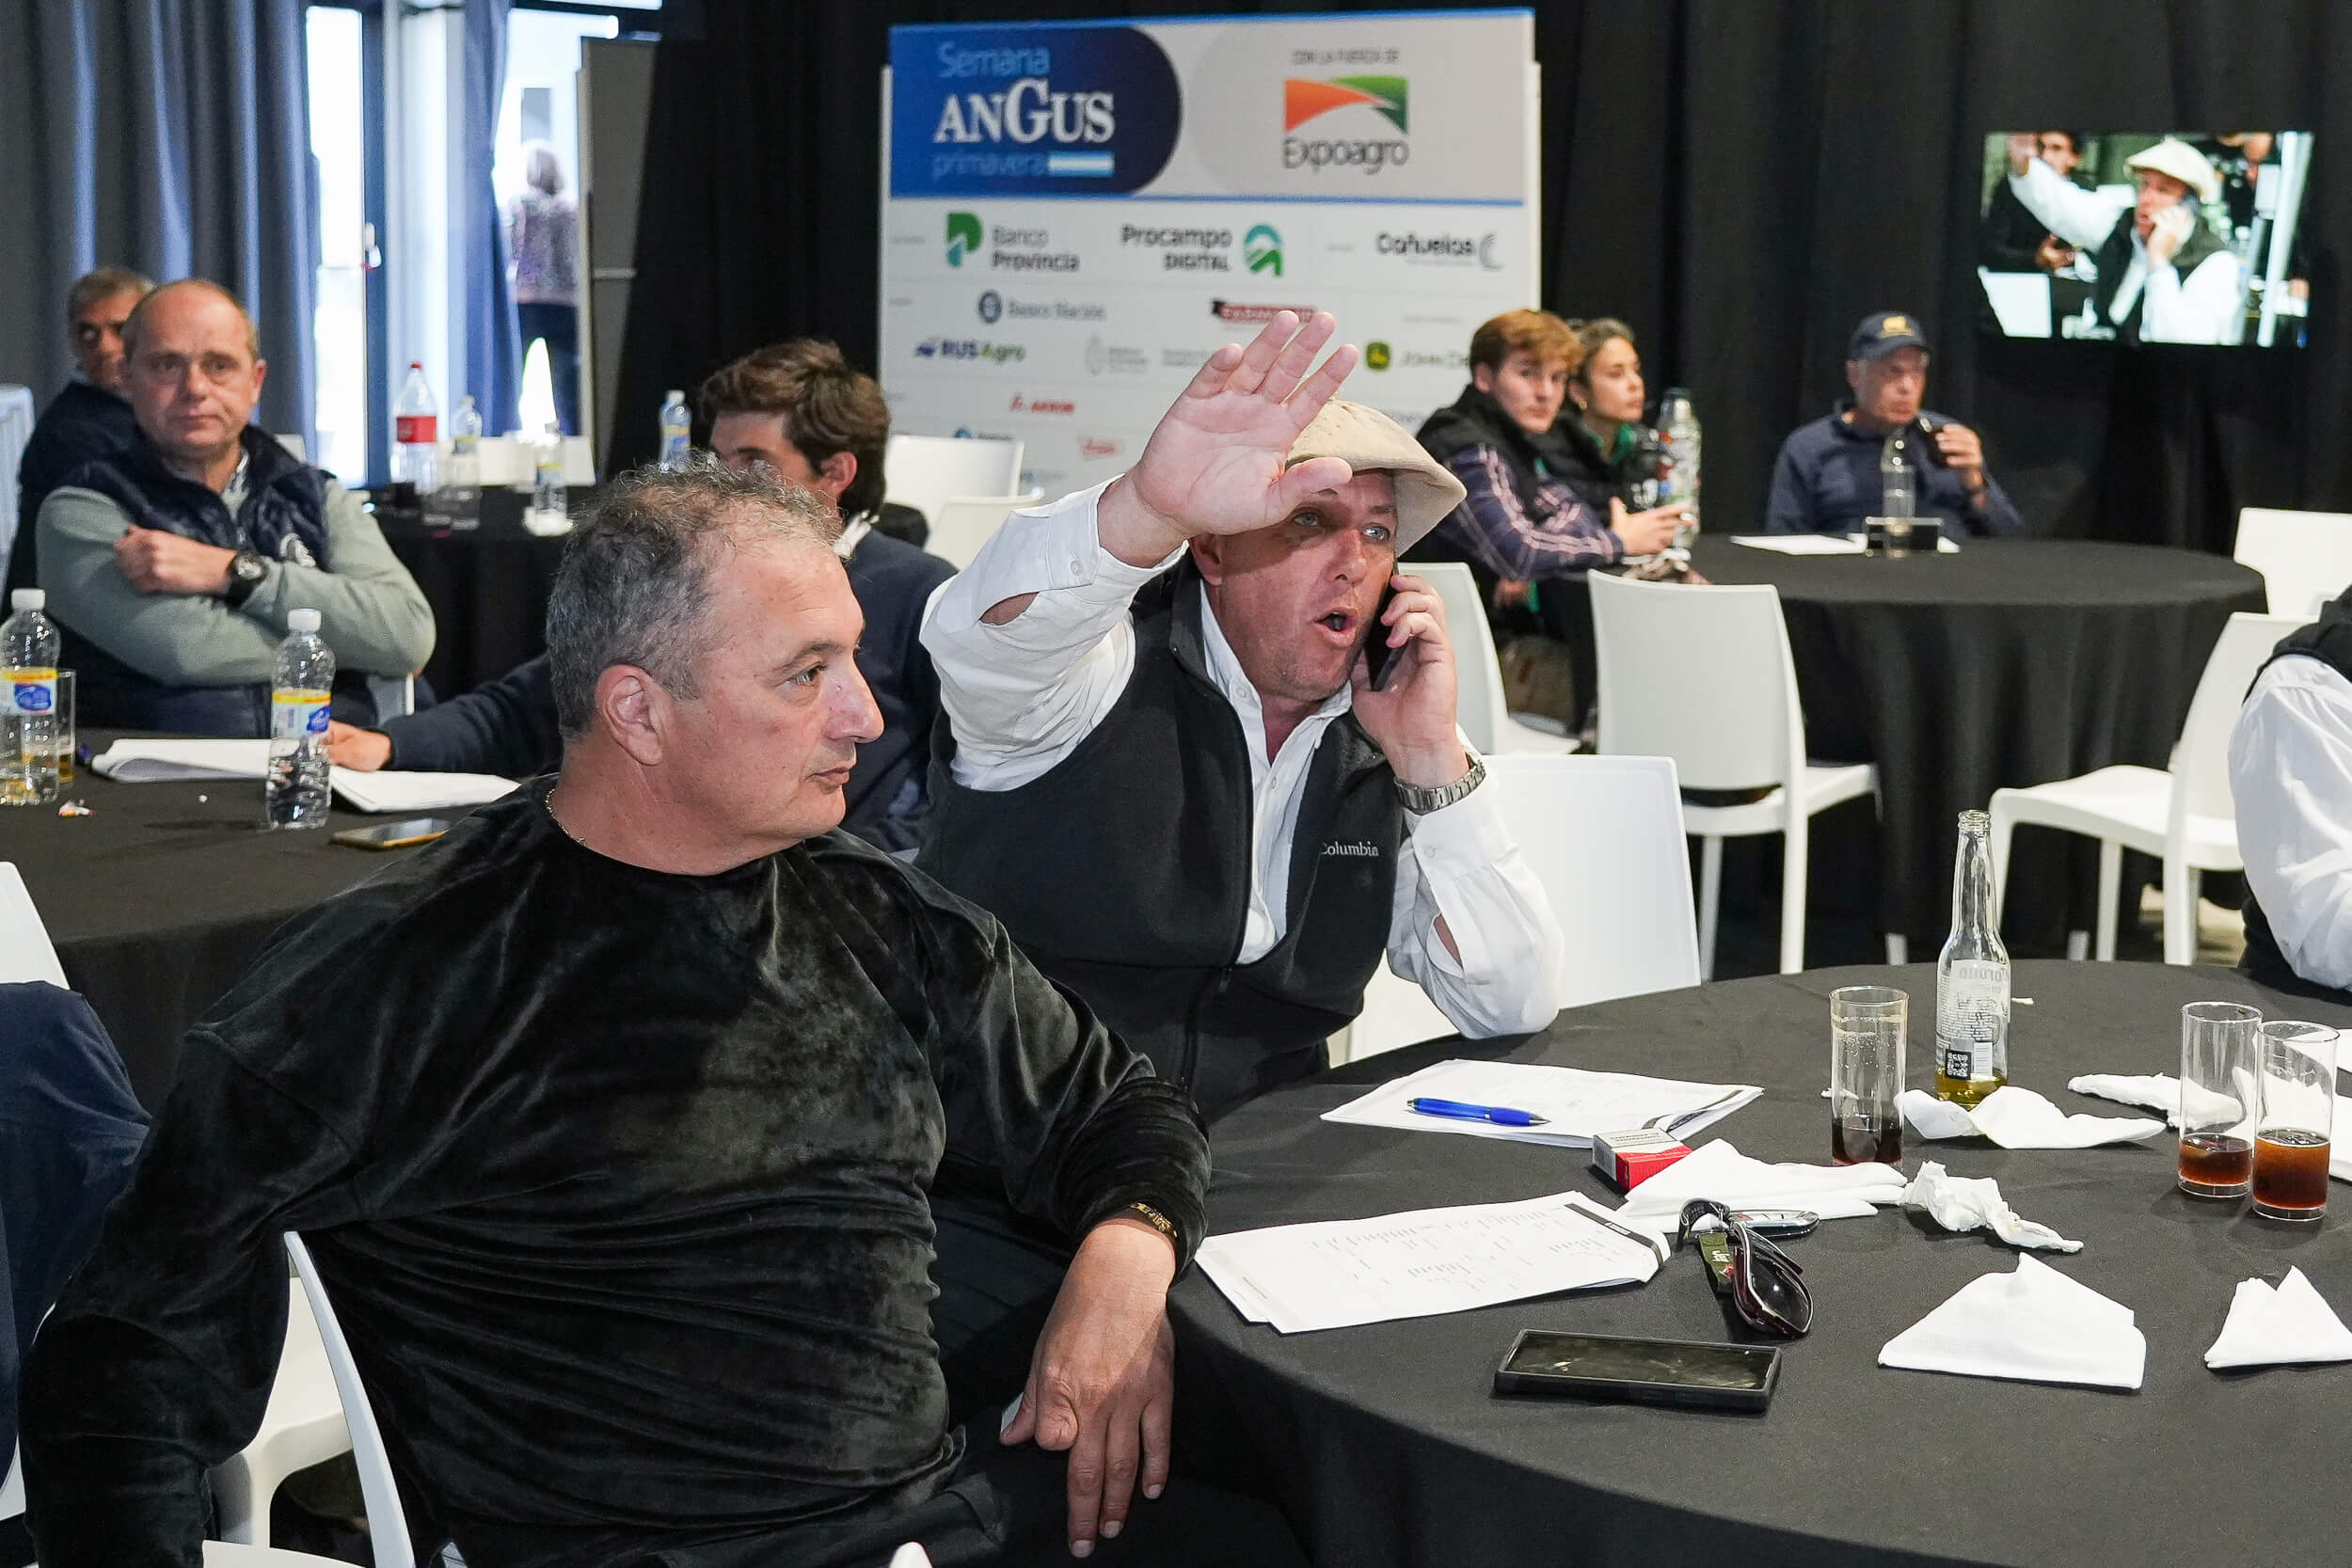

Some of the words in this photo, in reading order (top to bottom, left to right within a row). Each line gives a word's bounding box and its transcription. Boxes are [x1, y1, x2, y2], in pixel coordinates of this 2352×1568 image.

[939, 41, 1050, 77] Semana
[933, 152, 1047, 181] primavera
[1282, 136, 1409, 175] Expoagro
[992, 226, 1048, 247] Banco
[1121, 225, 1233, 248] Procampo
[992, 250, 1080, 273] Provincia
[1165, 253, 1231, 272] DIGITAL
